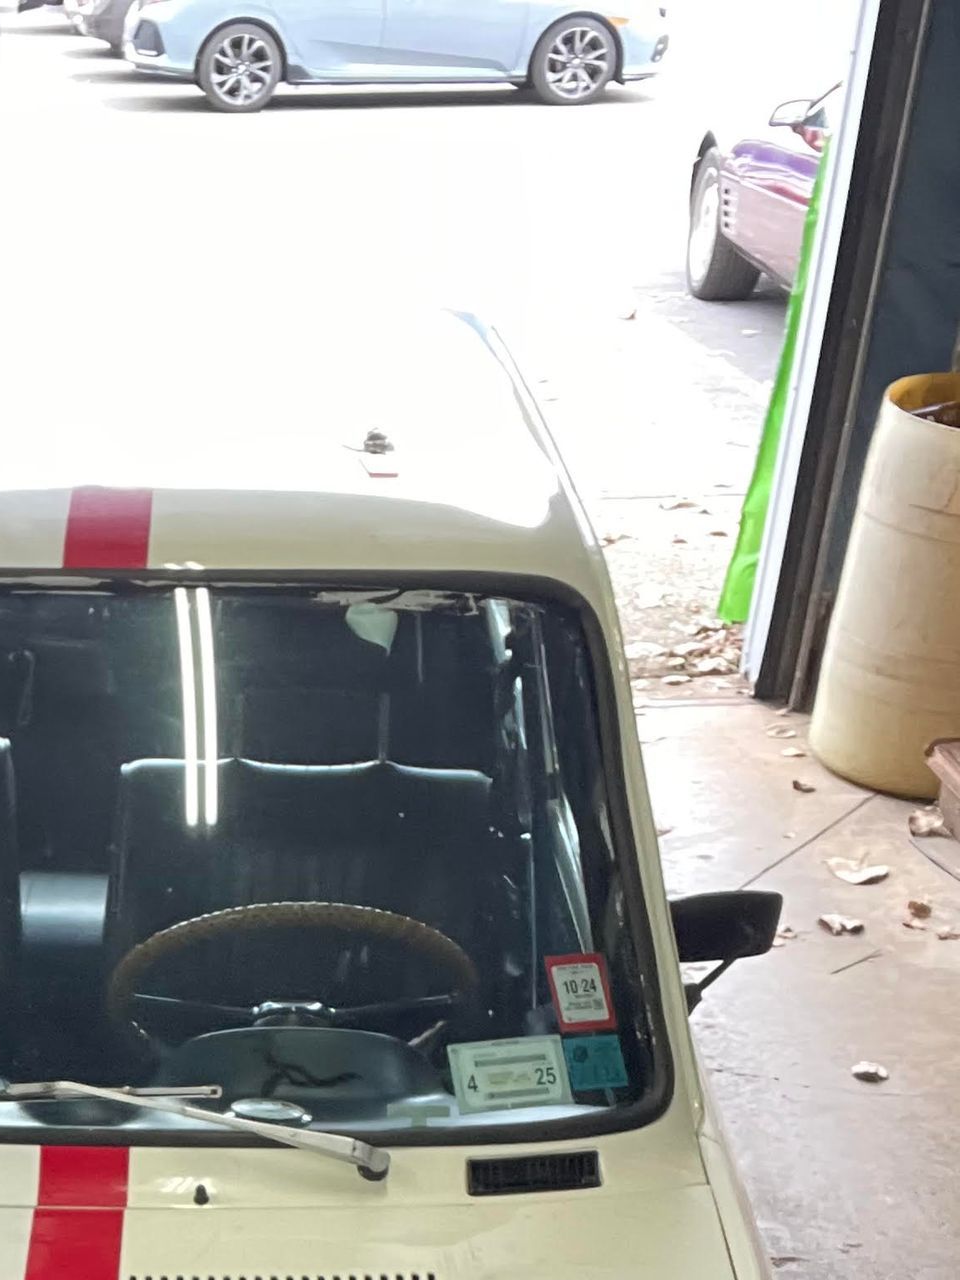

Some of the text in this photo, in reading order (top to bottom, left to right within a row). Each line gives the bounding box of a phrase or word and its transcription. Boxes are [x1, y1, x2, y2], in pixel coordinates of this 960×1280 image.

[562, 978, 597, 994] 10 24
[467, 1074, 479, 1093] 4
[534, 1067, 557, 1086] 25
